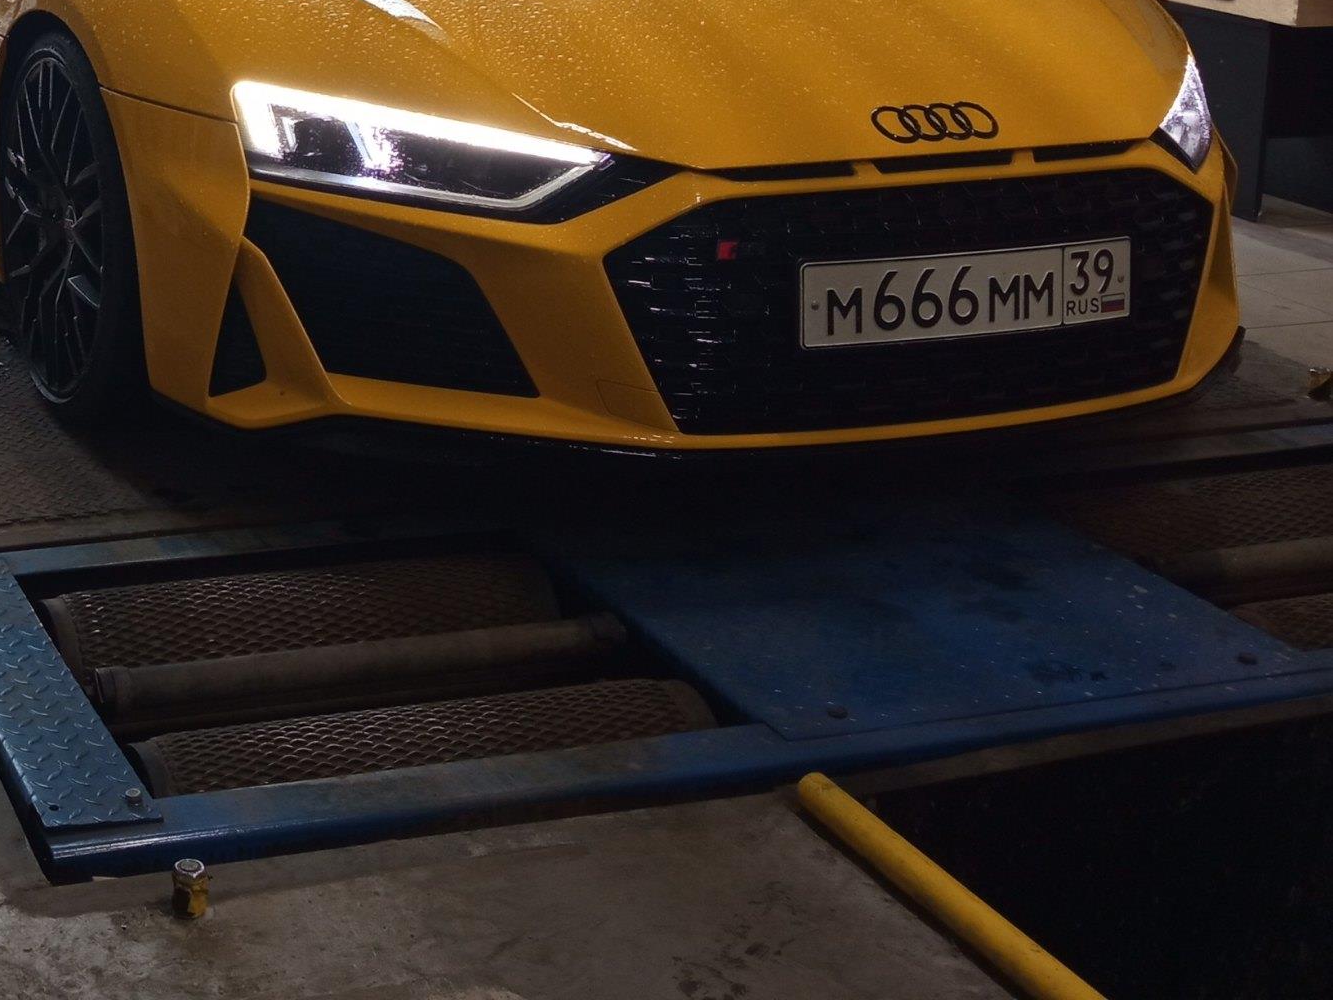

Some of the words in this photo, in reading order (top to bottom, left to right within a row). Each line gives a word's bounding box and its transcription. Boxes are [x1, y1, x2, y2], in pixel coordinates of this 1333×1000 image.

[826, 265, 1054, 336] М666ММ
[1070, 249, 1115, 295] 39
[1066, 297, 1100, 316] RUS
